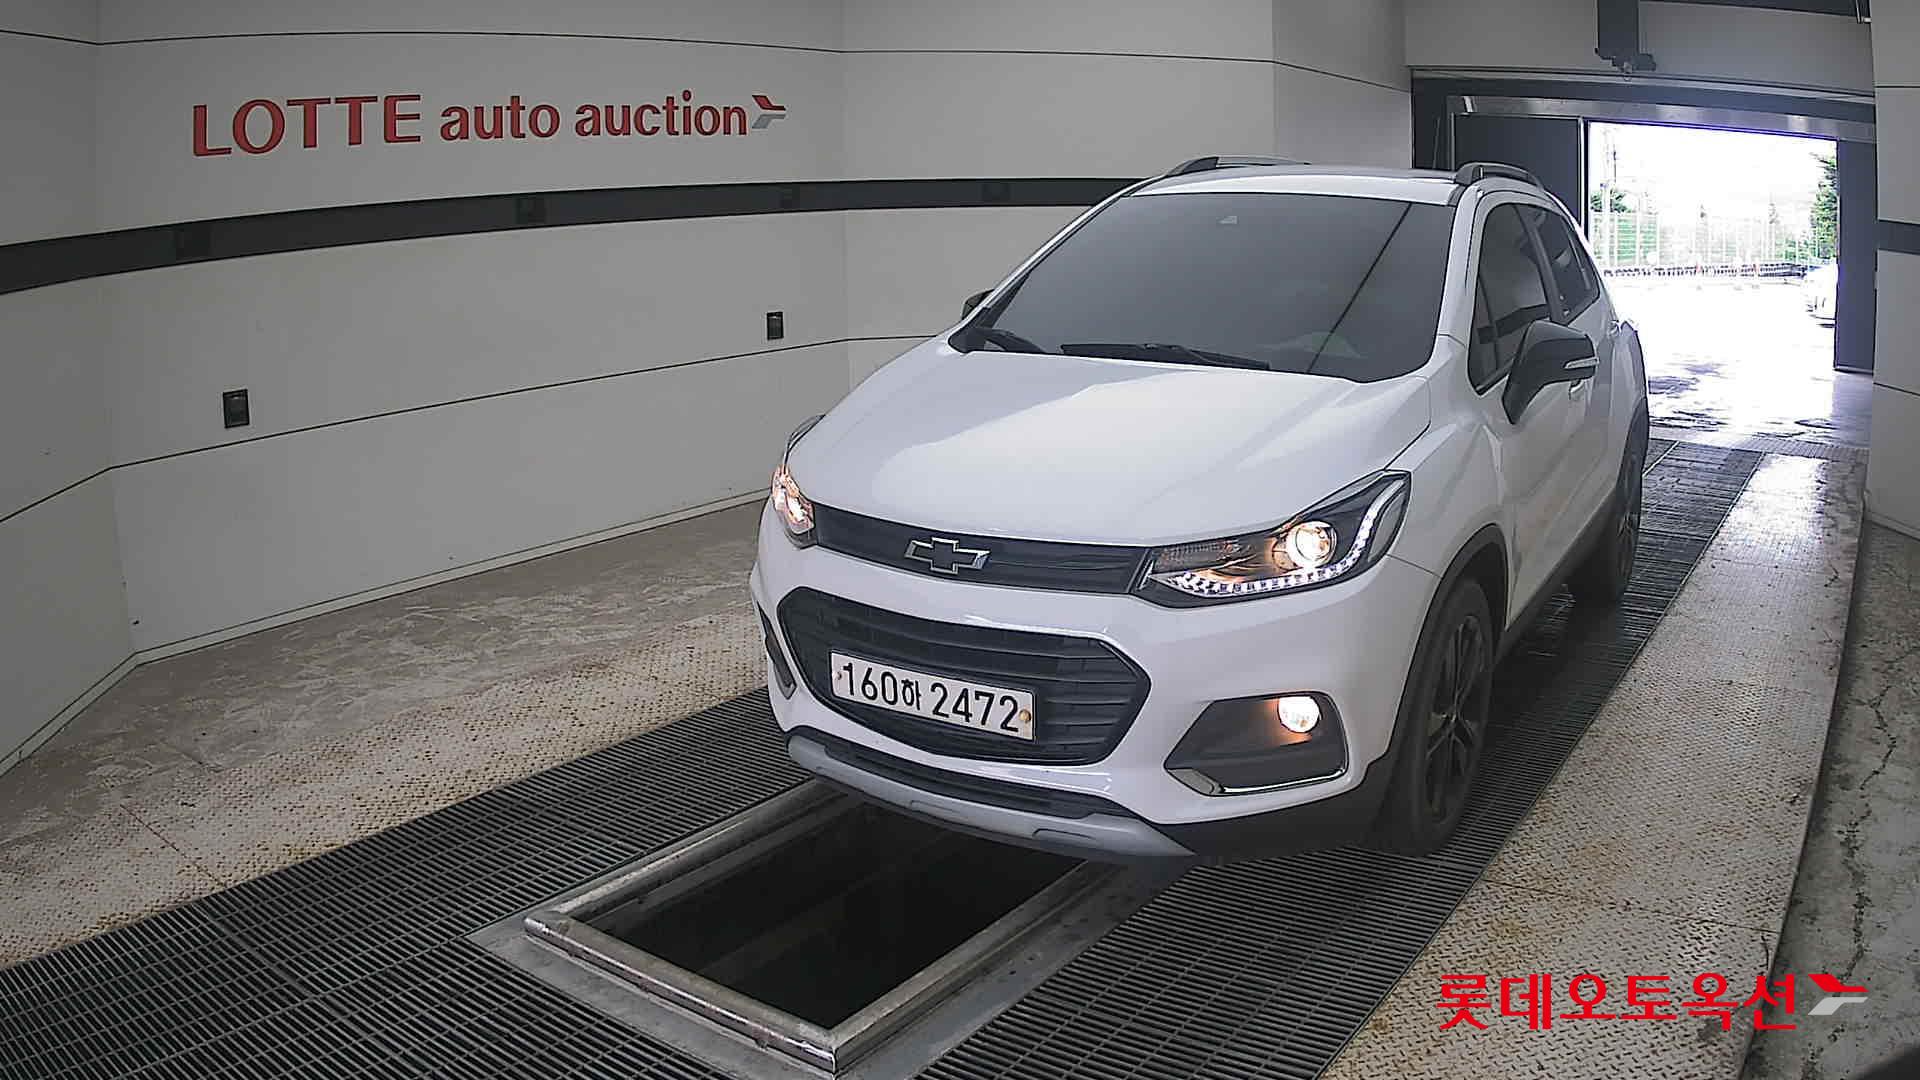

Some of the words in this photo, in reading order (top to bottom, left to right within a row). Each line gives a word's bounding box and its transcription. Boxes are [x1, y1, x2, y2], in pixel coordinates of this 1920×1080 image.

[193, 94, 421, 157] LOTTE
[440, 95, 561, 141] auto
[575, 89, 748, 137] auction
[843, 662, 922, 711] 160하
[930, 682, 1019, 733] 2472
